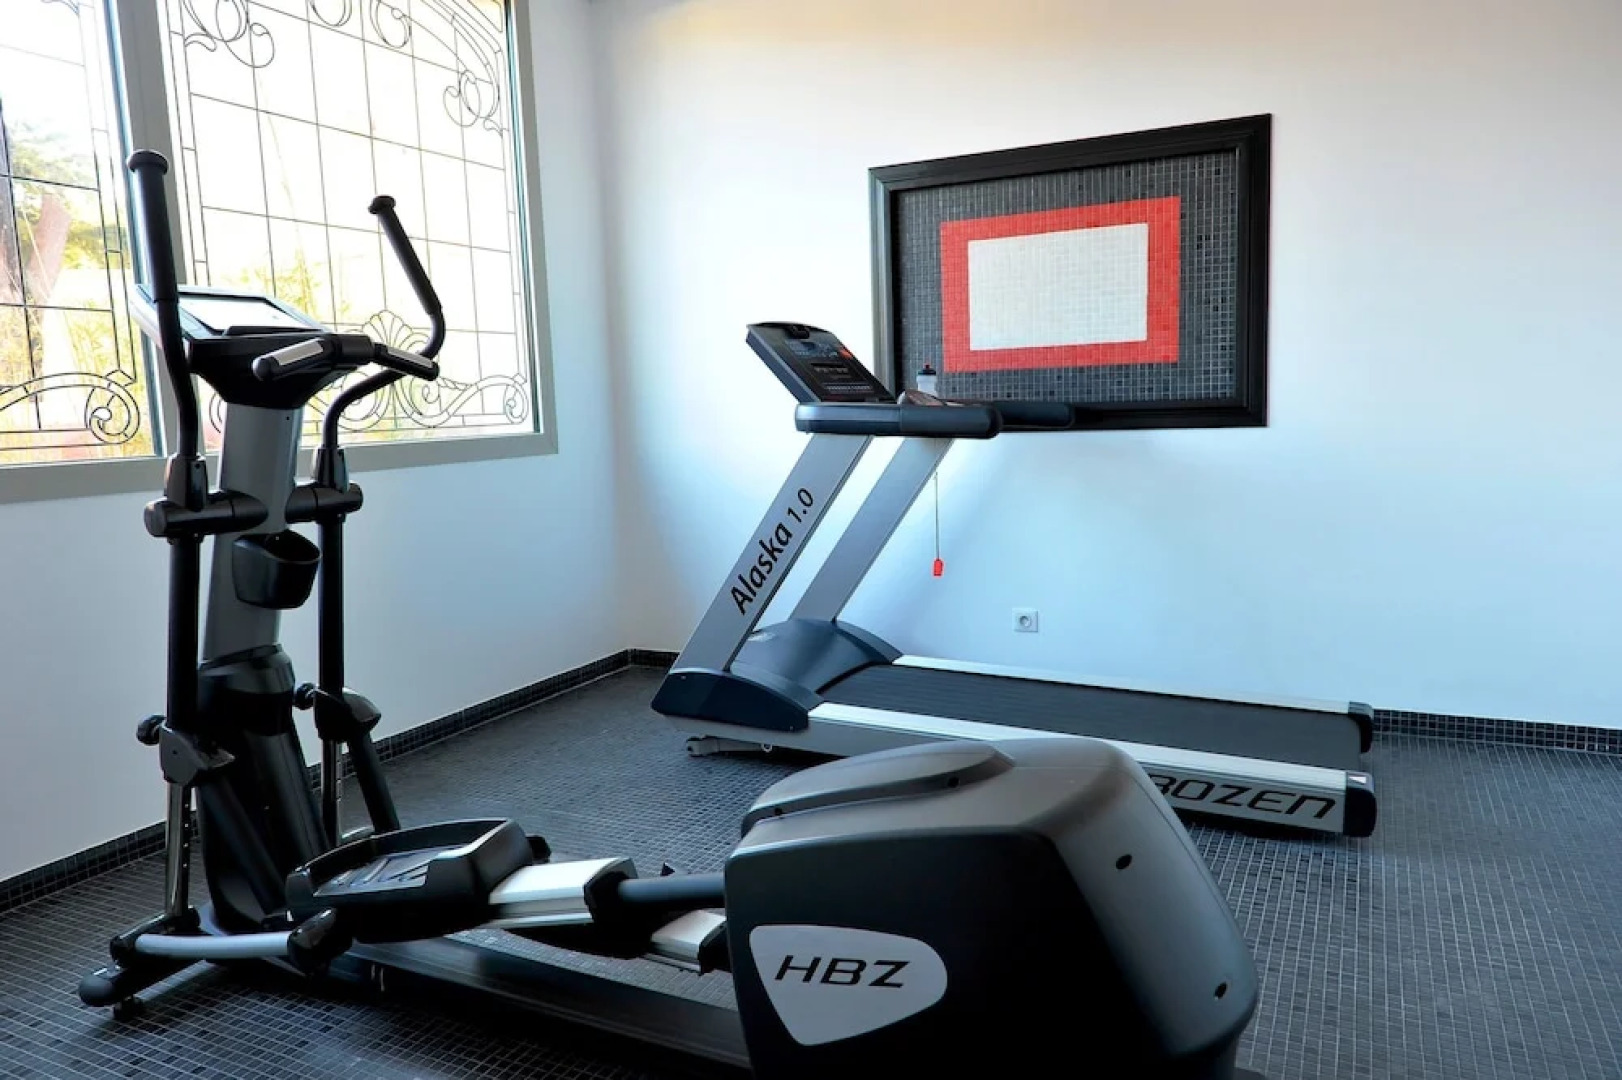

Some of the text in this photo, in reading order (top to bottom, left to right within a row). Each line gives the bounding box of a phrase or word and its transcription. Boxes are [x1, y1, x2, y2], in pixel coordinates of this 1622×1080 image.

[731, 488, 813, 615] Alaska 1.0
[774, 955, 910, 988] HBZ
